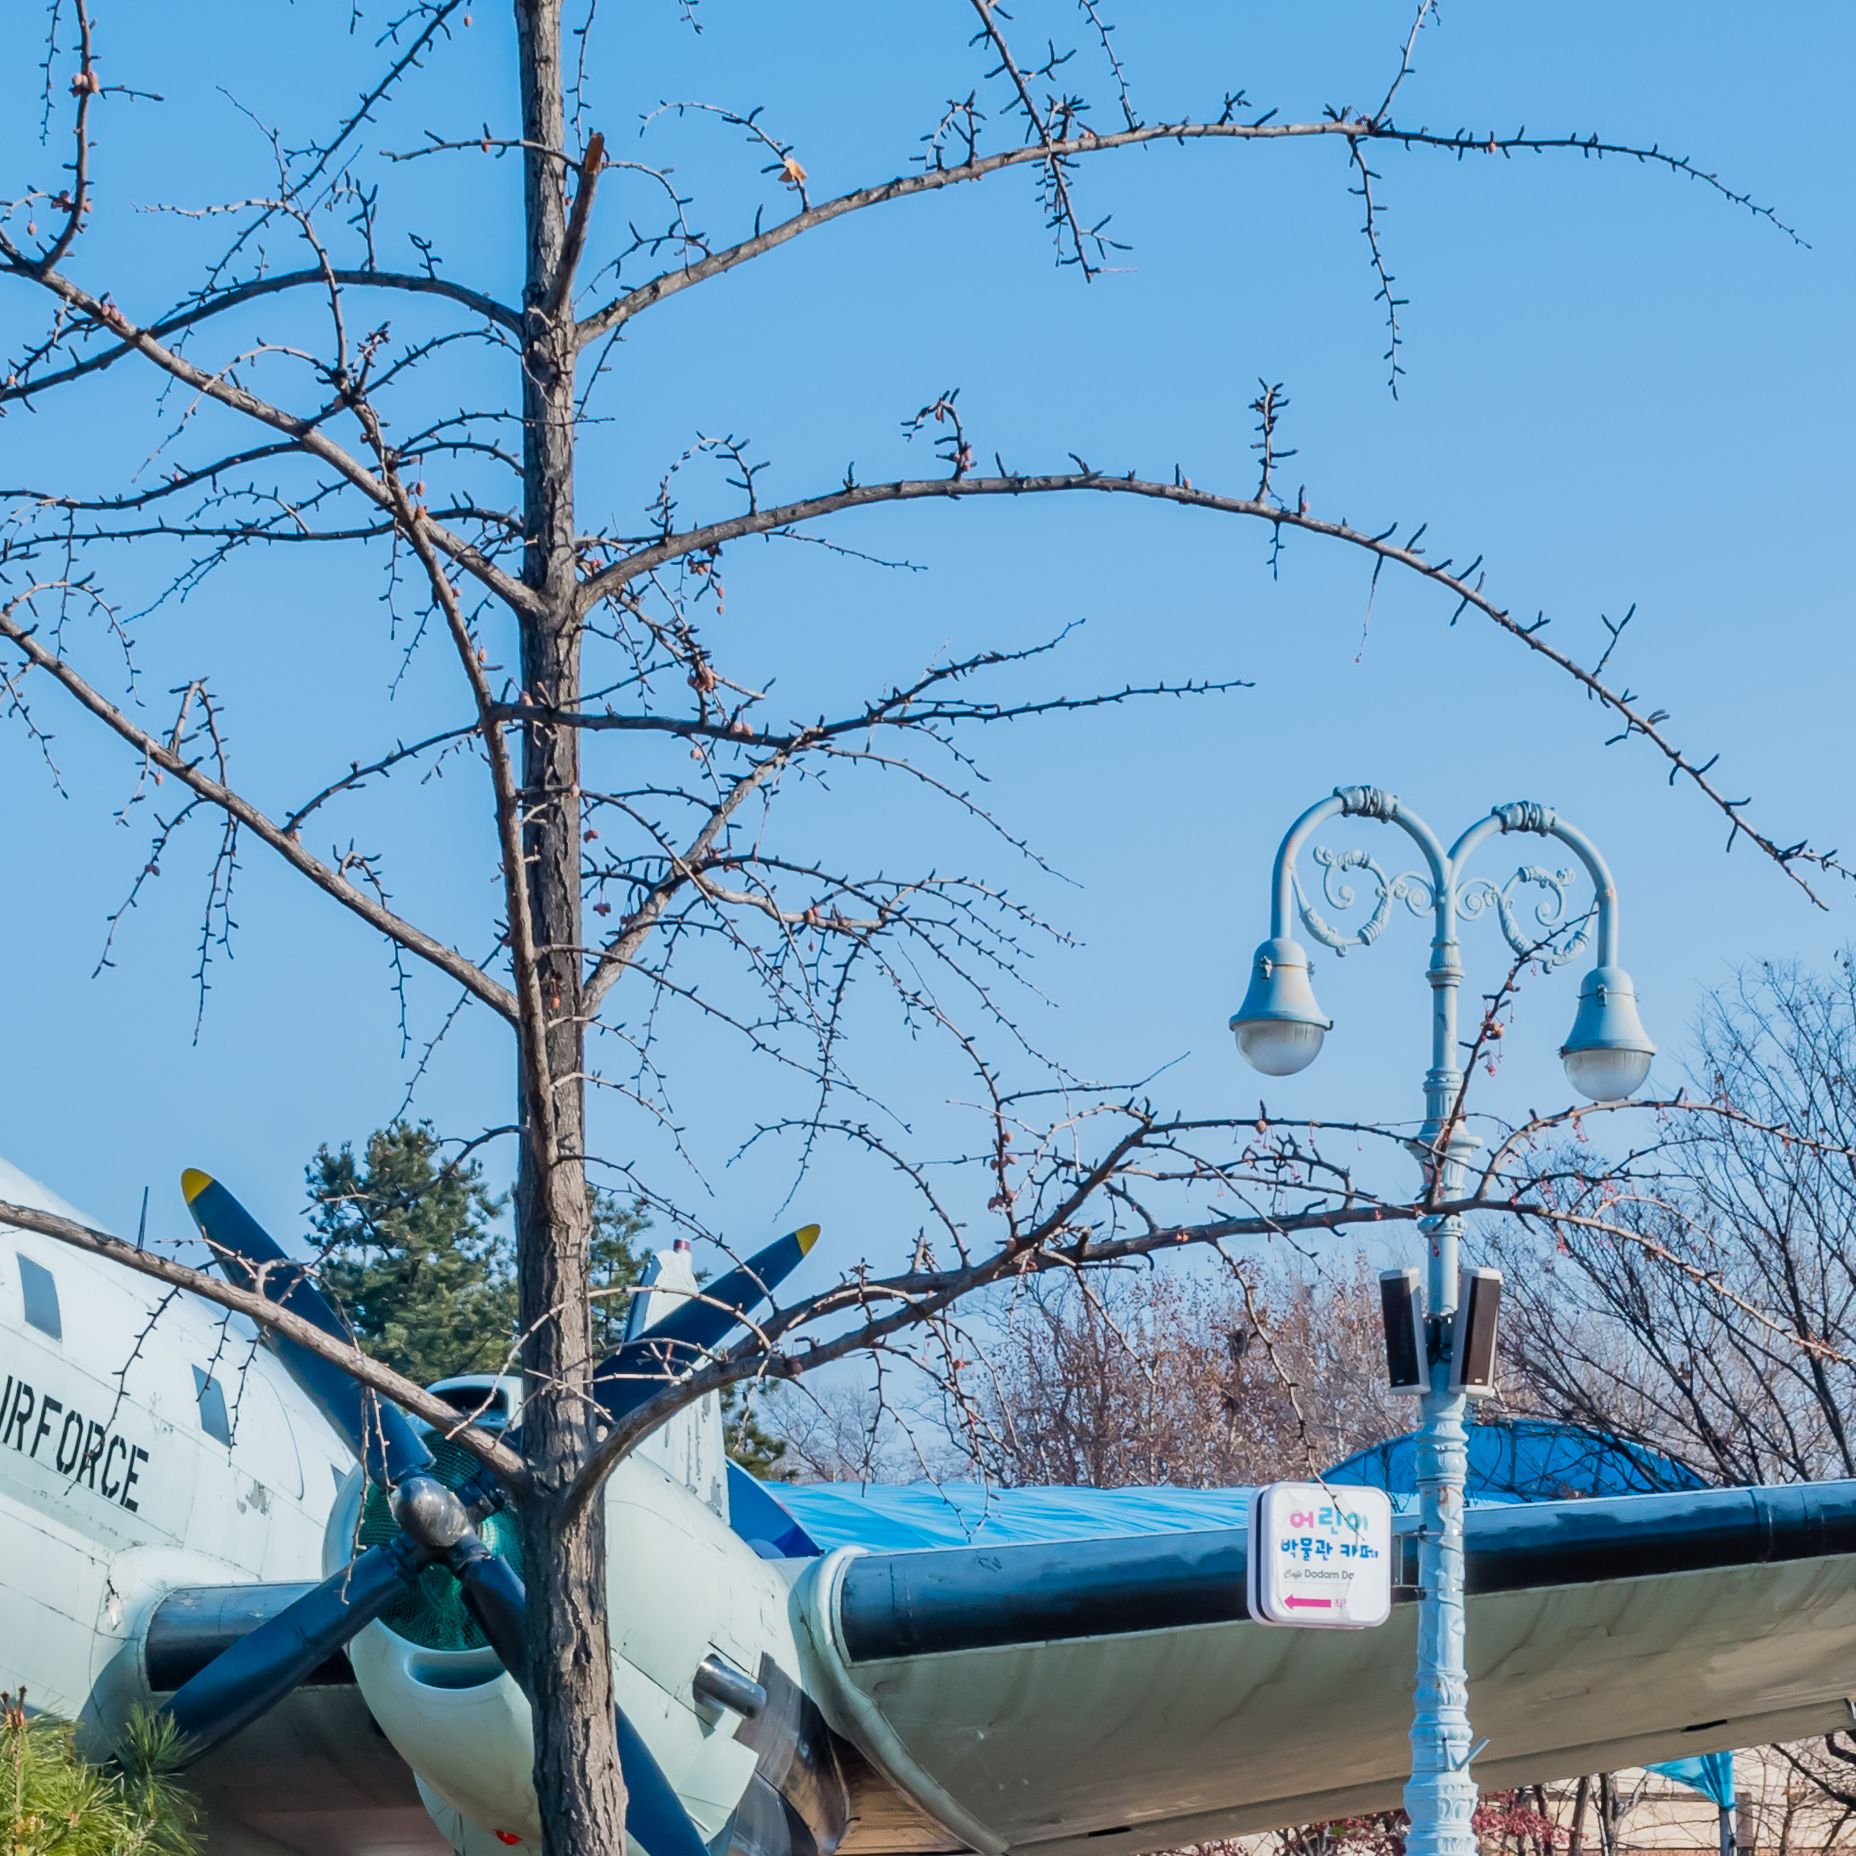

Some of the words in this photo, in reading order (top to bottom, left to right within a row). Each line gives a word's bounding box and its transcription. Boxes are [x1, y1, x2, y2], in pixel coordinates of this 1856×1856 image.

[1290, 1507, 1369, 1535] 어린이
[1281, 1538, 1334, 1561] 박물관
[1304, 1568, 1340, 1579] Dodam
